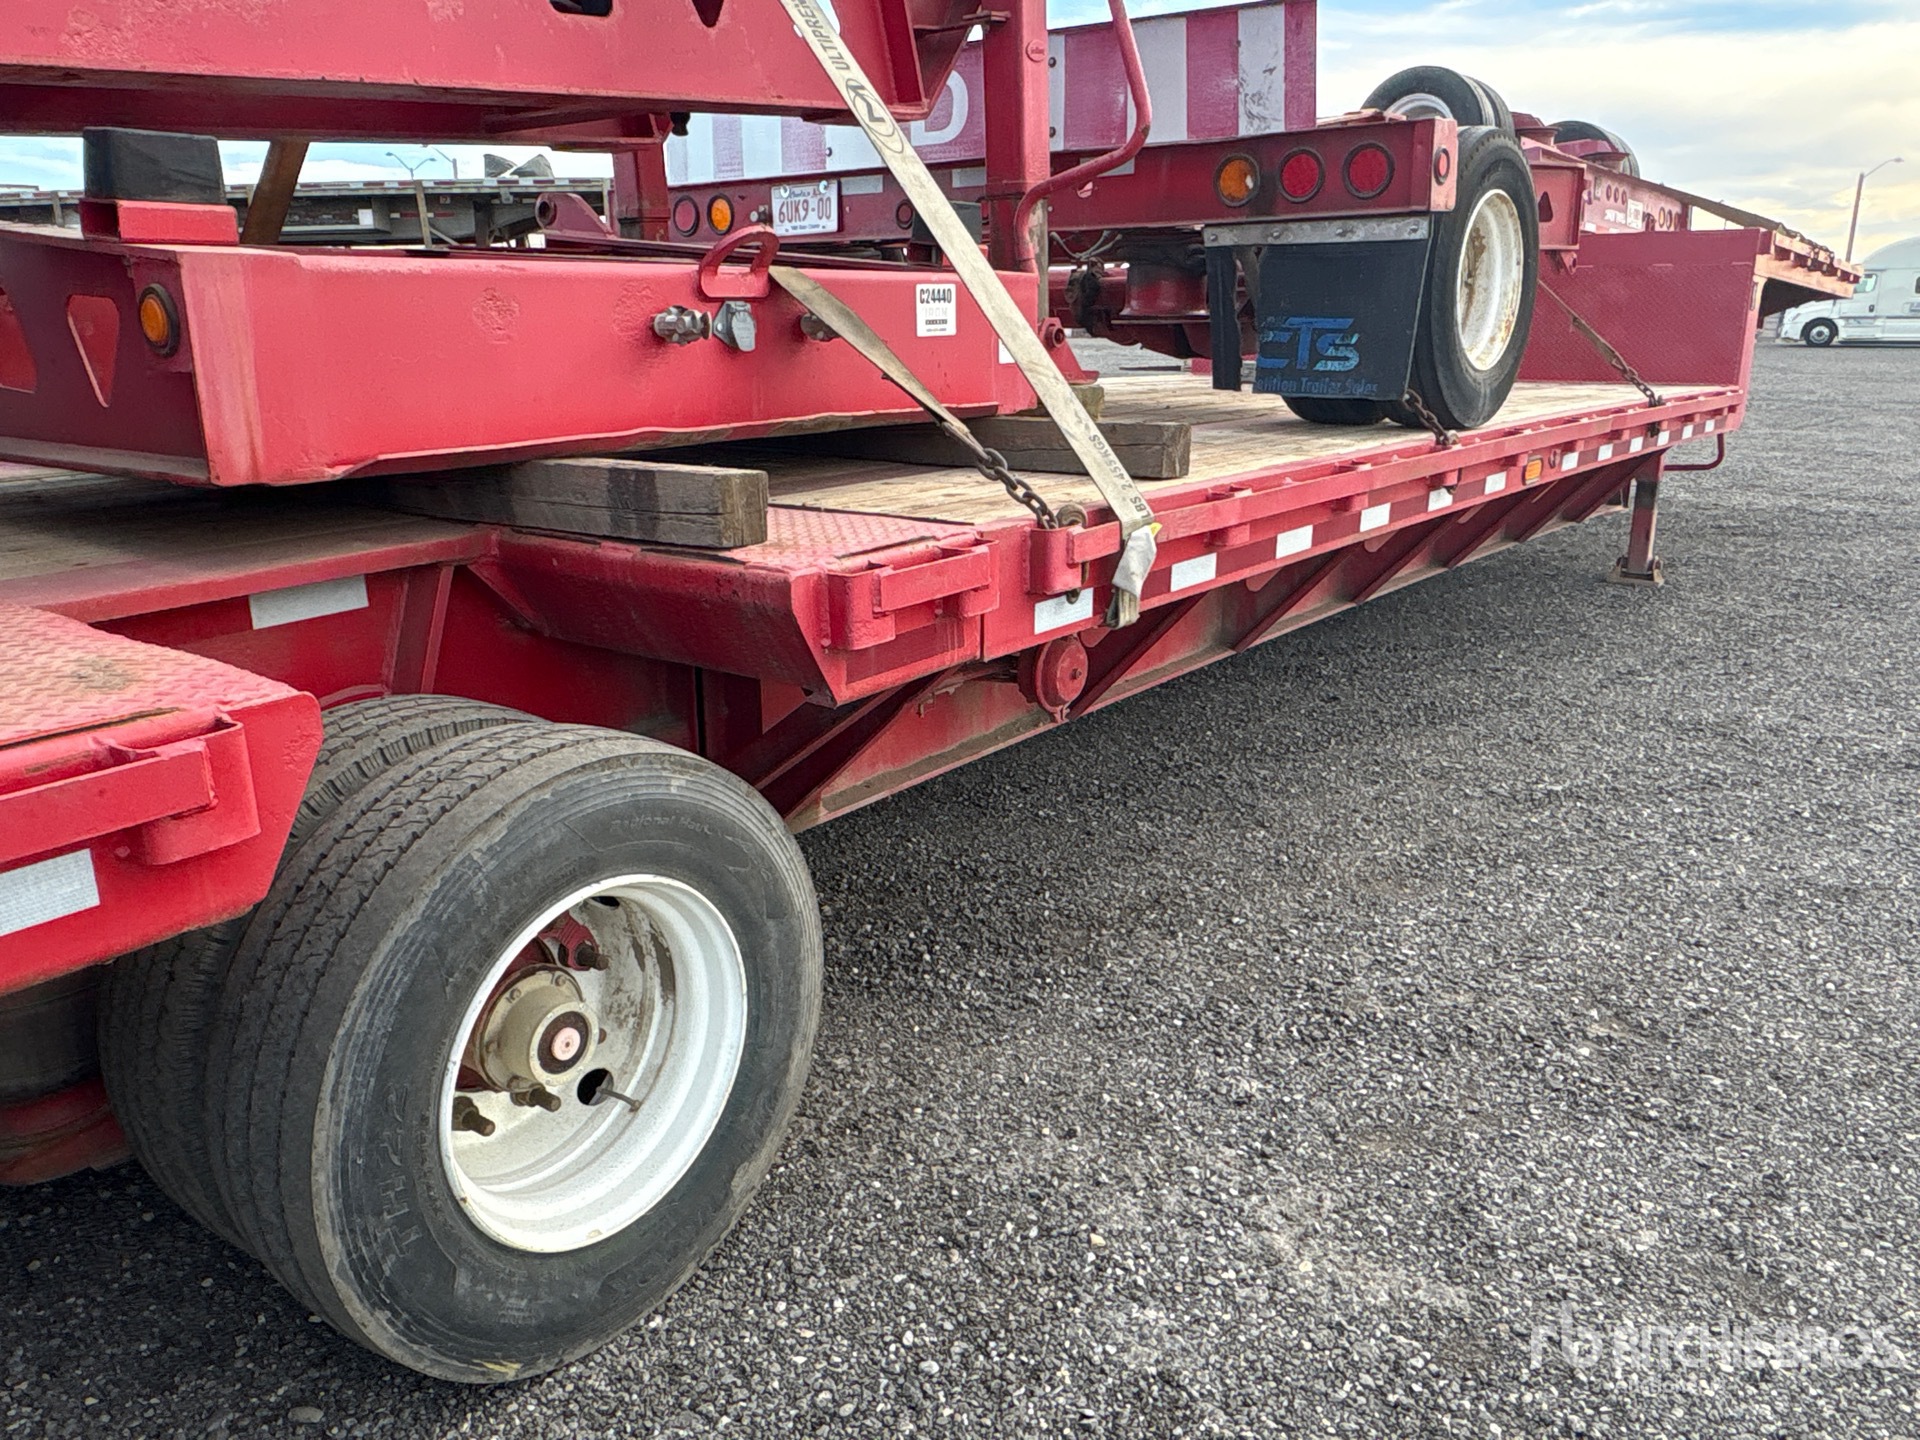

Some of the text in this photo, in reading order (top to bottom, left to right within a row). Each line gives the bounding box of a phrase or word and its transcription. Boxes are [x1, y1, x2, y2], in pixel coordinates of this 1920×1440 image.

[778, 196, 832, 224] 6UK9-00
[919, 288, 952, 304] C24440
[1301, 377, 1342, 394] Trailer
[1088, 434, 1111, 459] KGS
[1130, 496, 1153, 519] LBS
